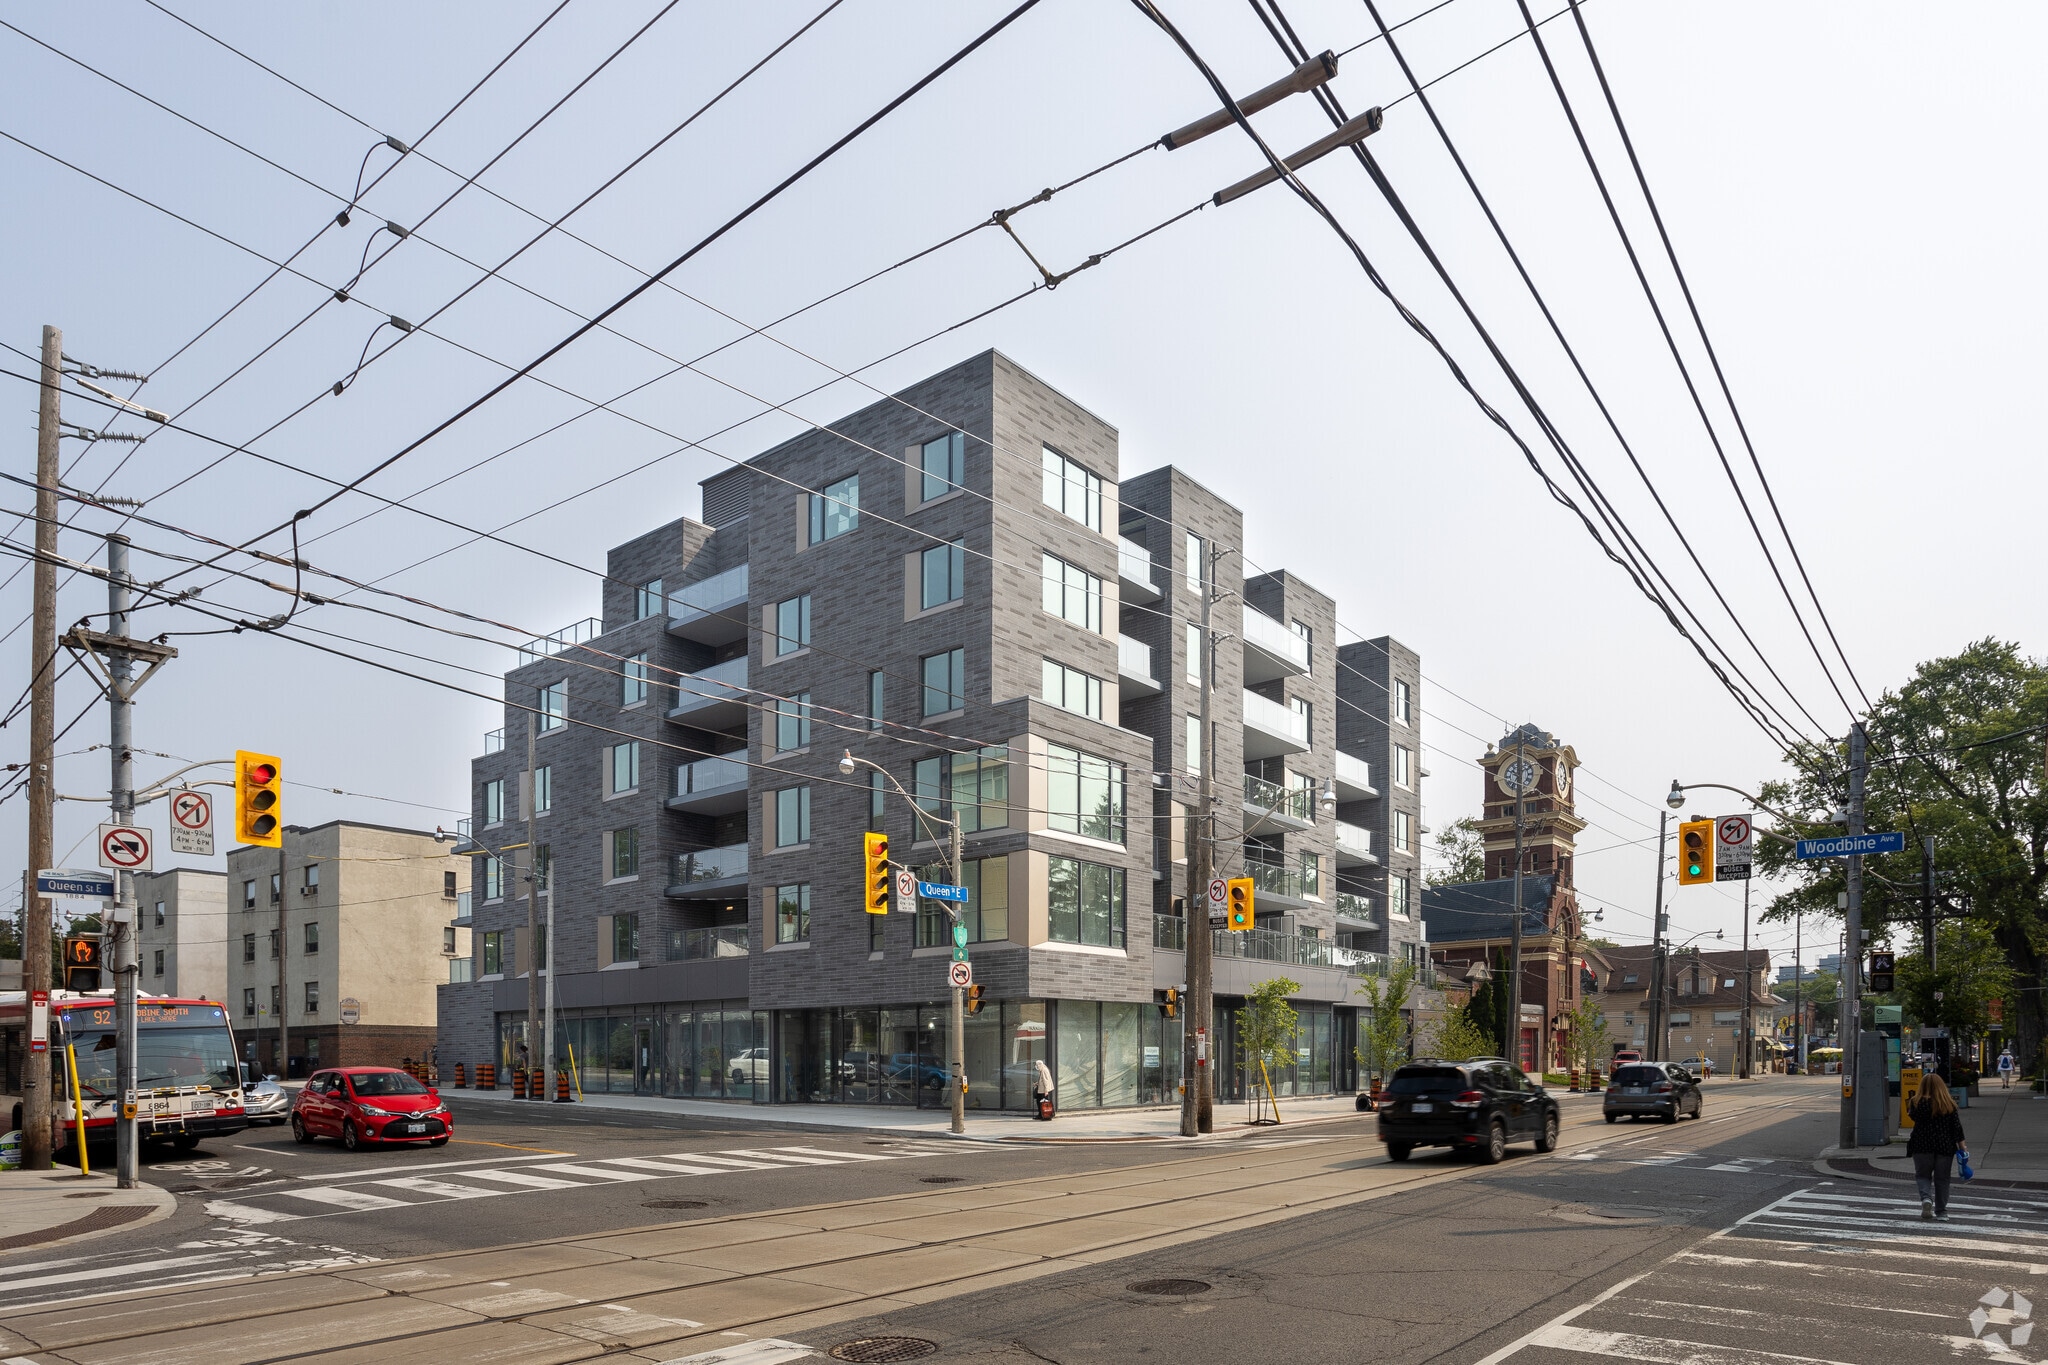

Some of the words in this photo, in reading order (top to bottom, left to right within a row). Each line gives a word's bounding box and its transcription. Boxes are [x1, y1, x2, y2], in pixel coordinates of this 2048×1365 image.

[1804, 837, 1876, 854] Woodbine
[1880, 835, 1895, 843] Ave
[1723, 865, 1743, 873] BUSES
[48, 880, 83, 892] Queen
[85, 884, 93, 893] St
[96, 883, 102, 893] E
[926, 884, 950, 896] Queen
[956, 888, 961, 898] E
[93, 1010, 111, 1025] 92
[163, 1007, 189, 1016] SOUTH
